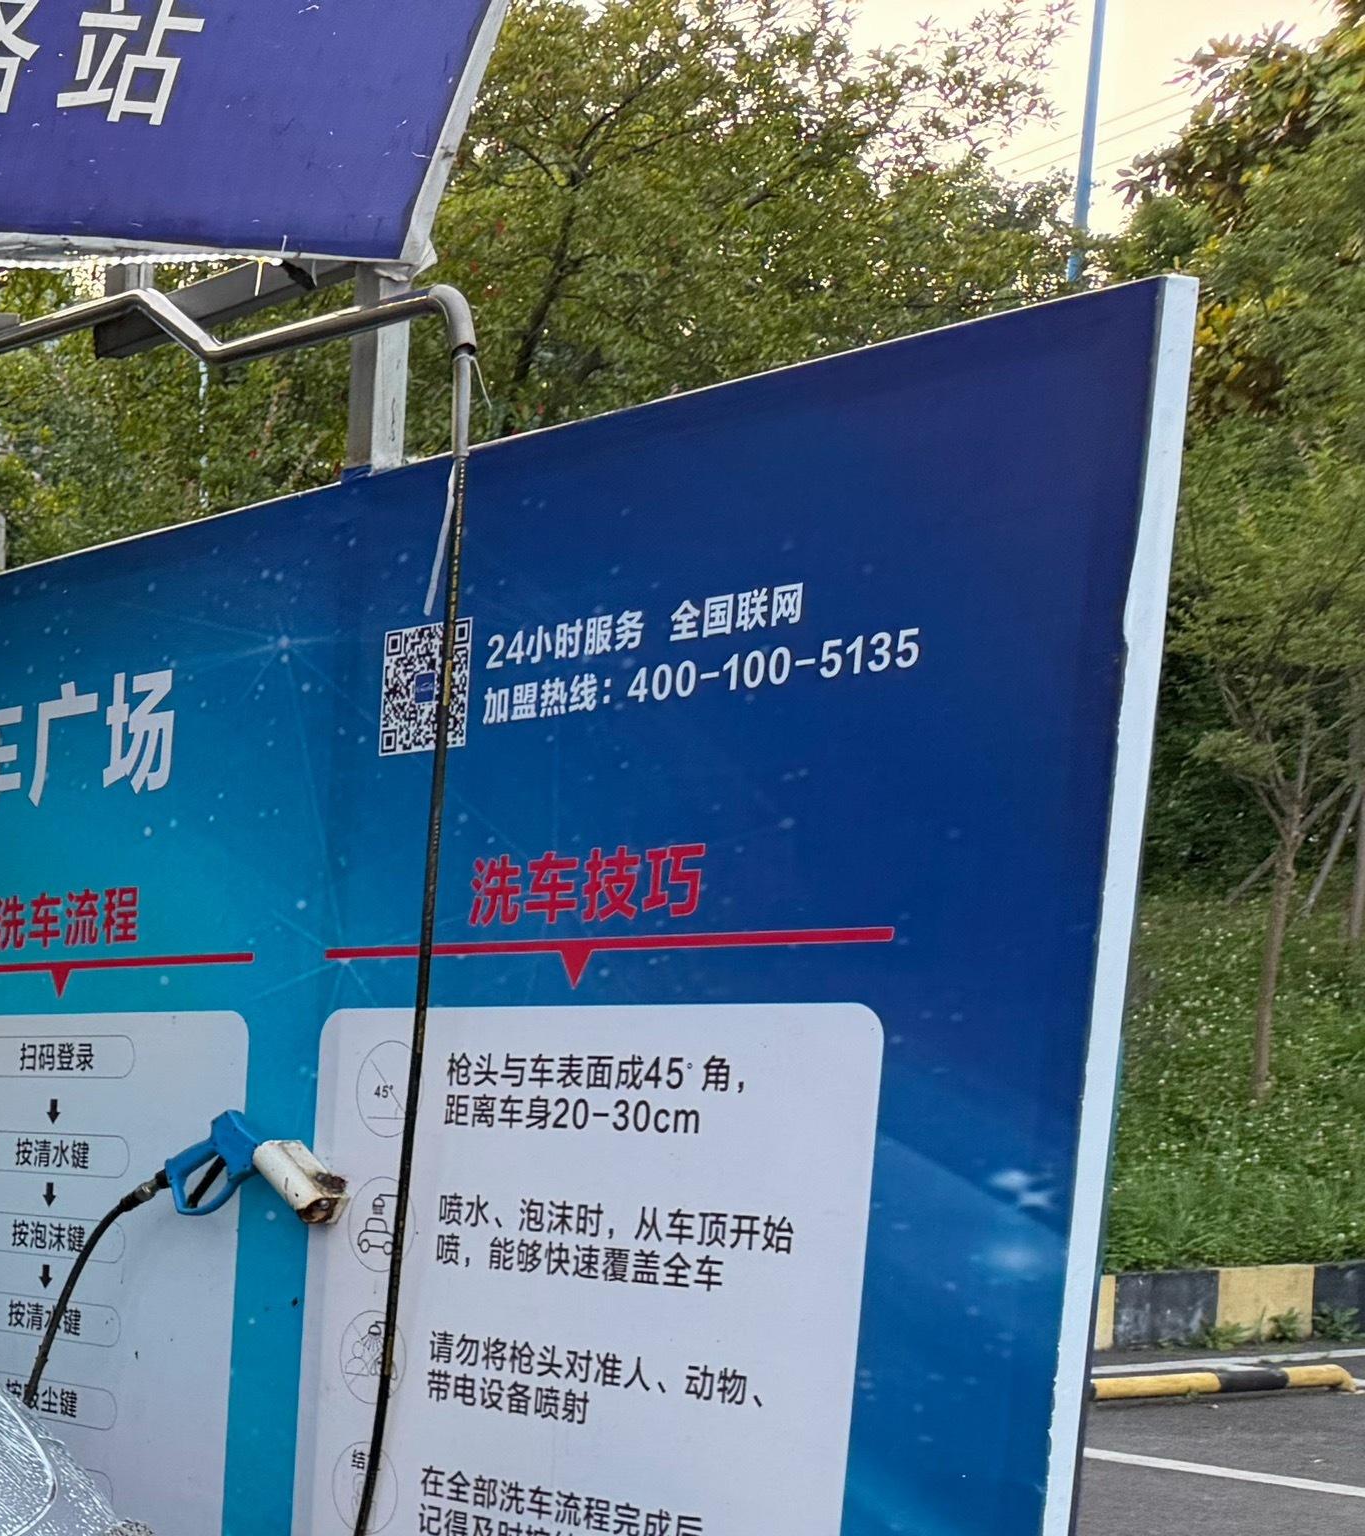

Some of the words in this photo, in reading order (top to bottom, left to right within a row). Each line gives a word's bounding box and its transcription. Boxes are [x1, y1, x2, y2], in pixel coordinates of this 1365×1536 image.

[485, 609, 645, 669] 24小时服务
[668, 581, 804, 642] 全国联网
[469, 842, 707, 927] 洗车技巧
[19, 1042, 95, 1073] 扫码登录
[444, 1094, 701, 1136] 距离车身20-30cm
[14, 1136, 90, 1171] 按清水键
[11, 1218, 86, 1253] 按泡沫键
[437, 1193, 796, 1255] 喷水、泡沫时，从车顶开始
[435, 1233, 725, 1292] 喷，能够快速覆盖全车
[426, 1370, 590, 1425] 带电设备喷射
[428, 1331, 765, 1409] 请勿将枪头对准人、动物、
